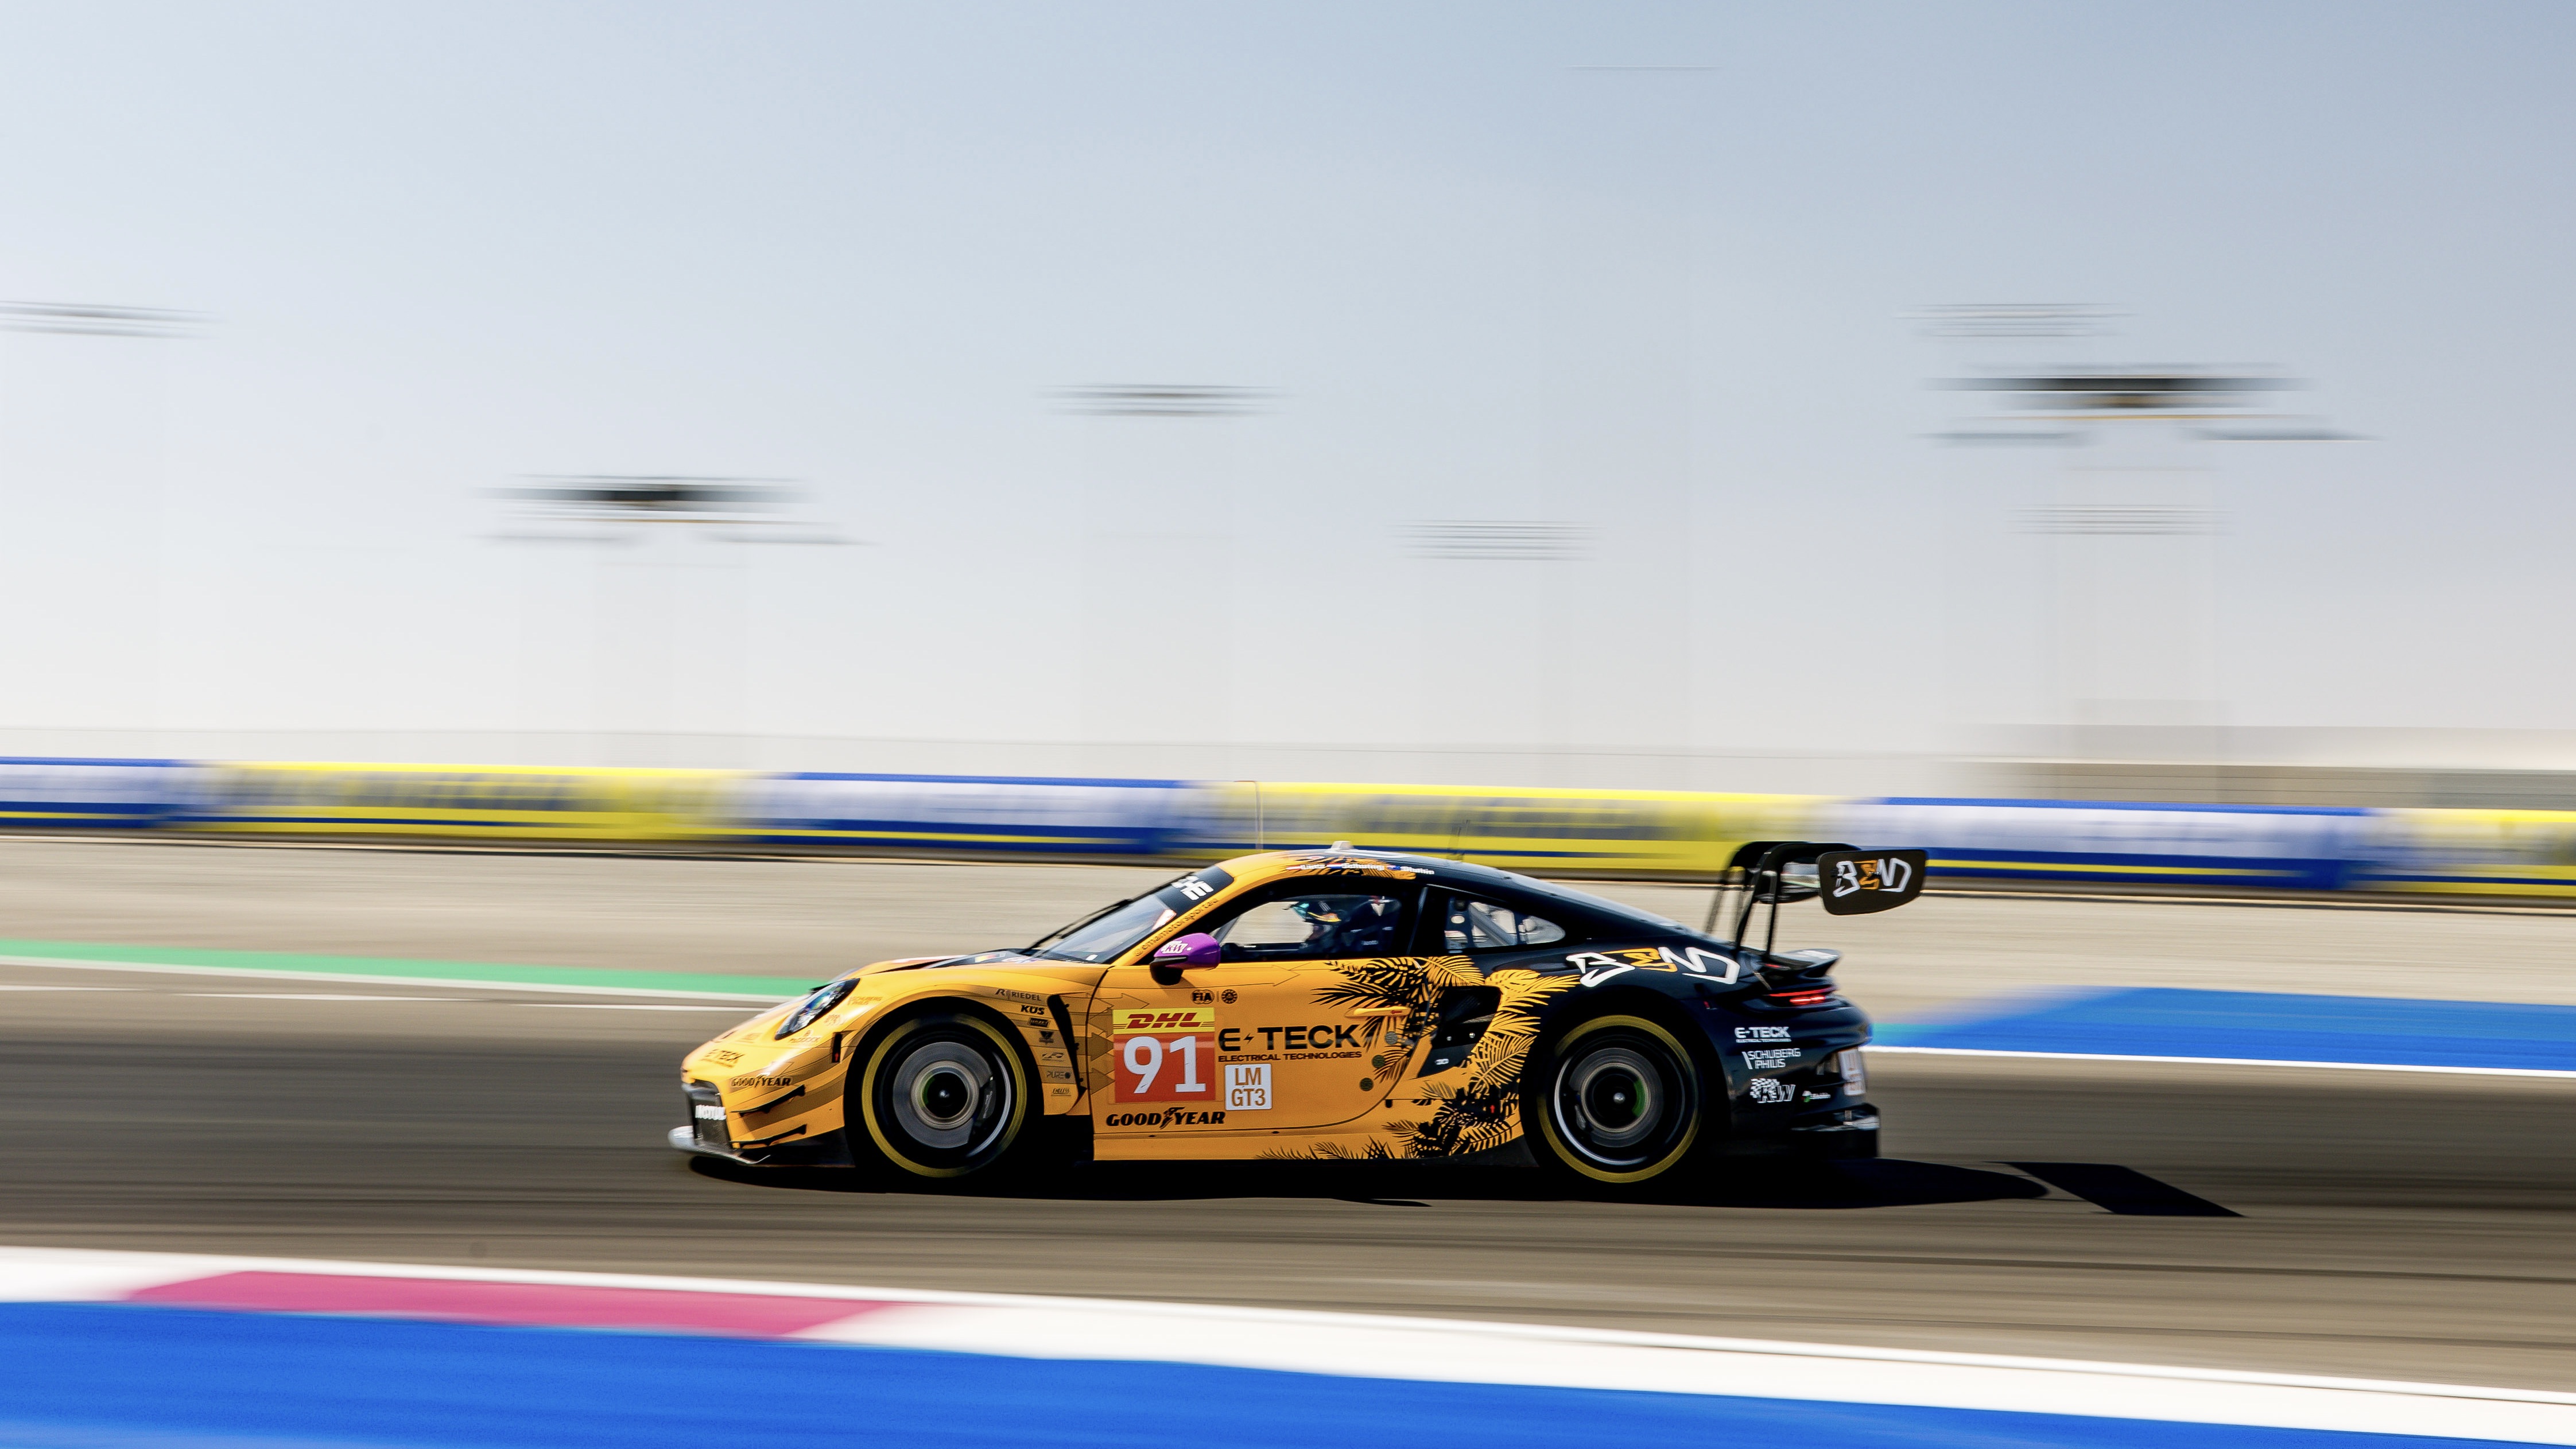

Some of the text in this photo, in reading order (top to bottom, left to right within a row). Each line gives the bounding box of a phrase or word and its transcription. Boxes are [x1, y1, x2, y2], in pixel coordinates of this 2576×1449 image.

[1011, 992, 1042, 1001] RIEDEL
[1127, 1012, 1202, 1029] DHL
[1123, 1035, 1206, 1094] 91
[1219, 1051, 1362, 1062] ELECTRICAL TECHNOLOGIES
[731, 1075, 792, 1087] GOODYEAR
[1235, 1067, 1262, 1086] LM
[1231, 1088, 1266, 1106] GT3
[1106, 1107, 1225, 1129] GOODYEAR
